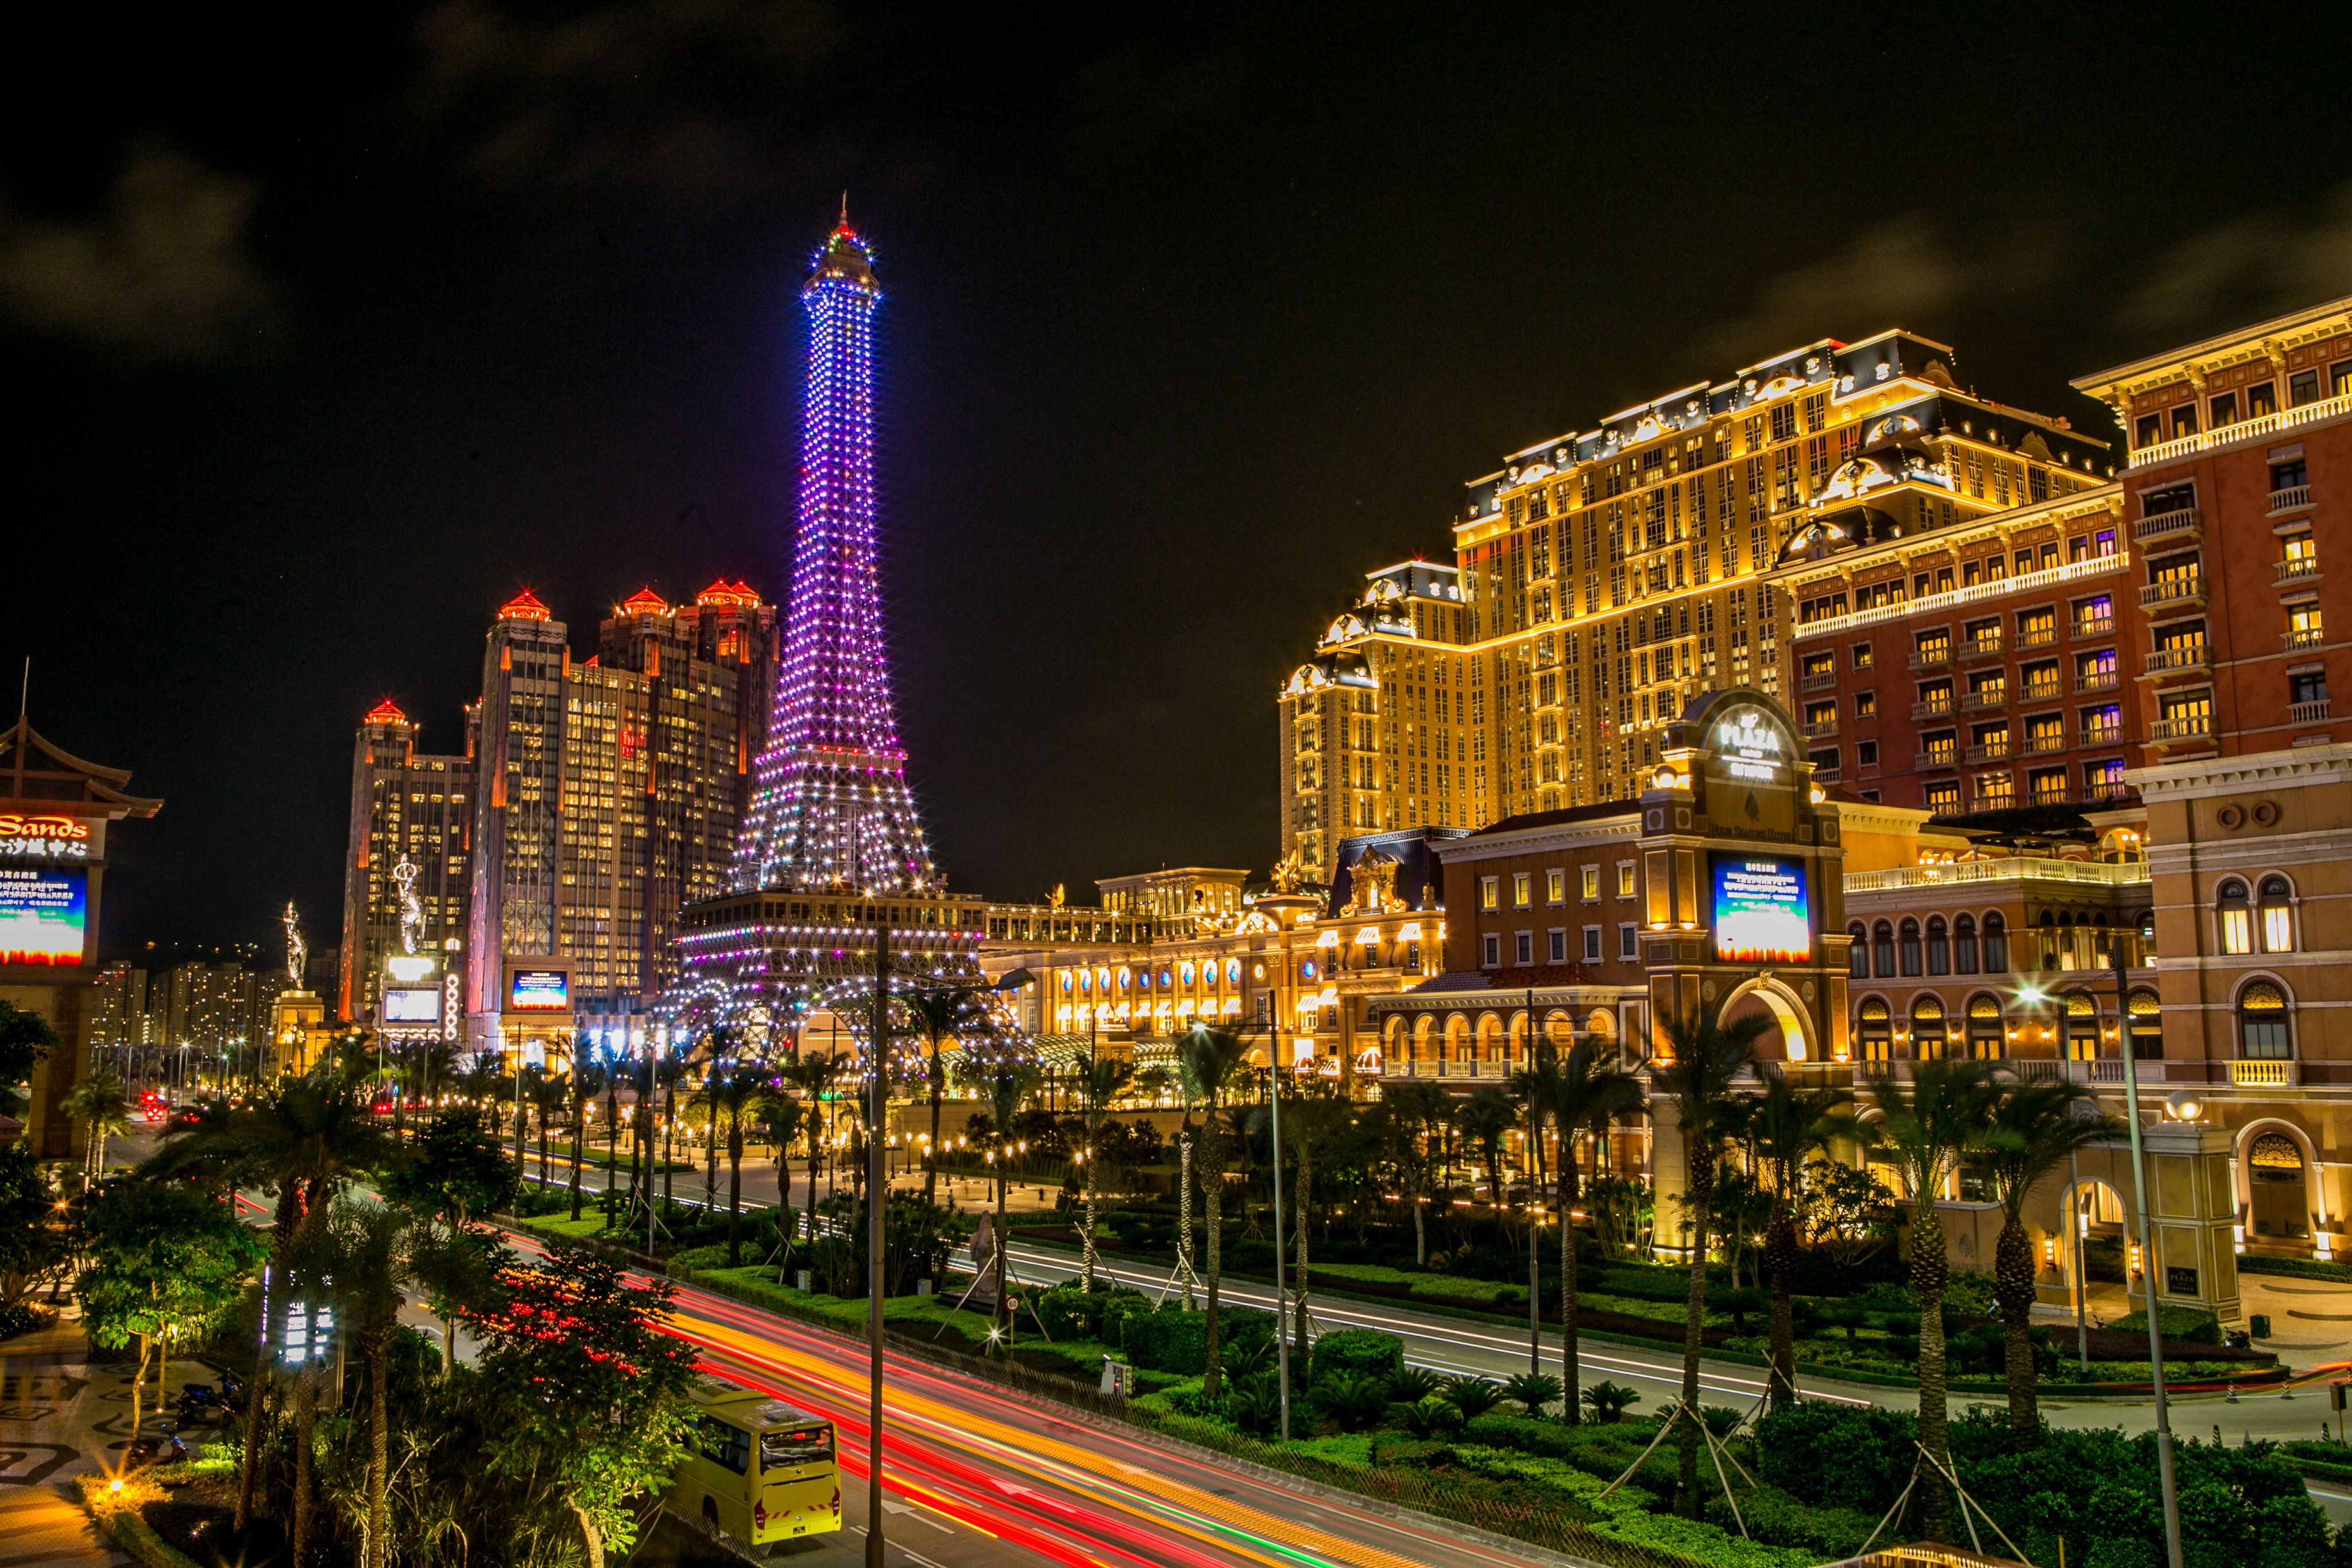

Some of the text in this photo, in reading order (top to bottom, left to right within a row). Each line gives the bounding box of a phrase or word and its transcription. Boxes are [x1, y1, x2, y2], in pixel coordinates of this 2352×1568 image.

[1720, 725, 1779, 751] PLAZA
[0, 815, 87, 838] Sands
[1712, 824, 1732, 837] FOUR
[1734, 826, 1766, 839] SEASONS
[1948, 1261, 1983, 1272] EASONS
[2171, 1274, 2194, 1282] PLAZA
